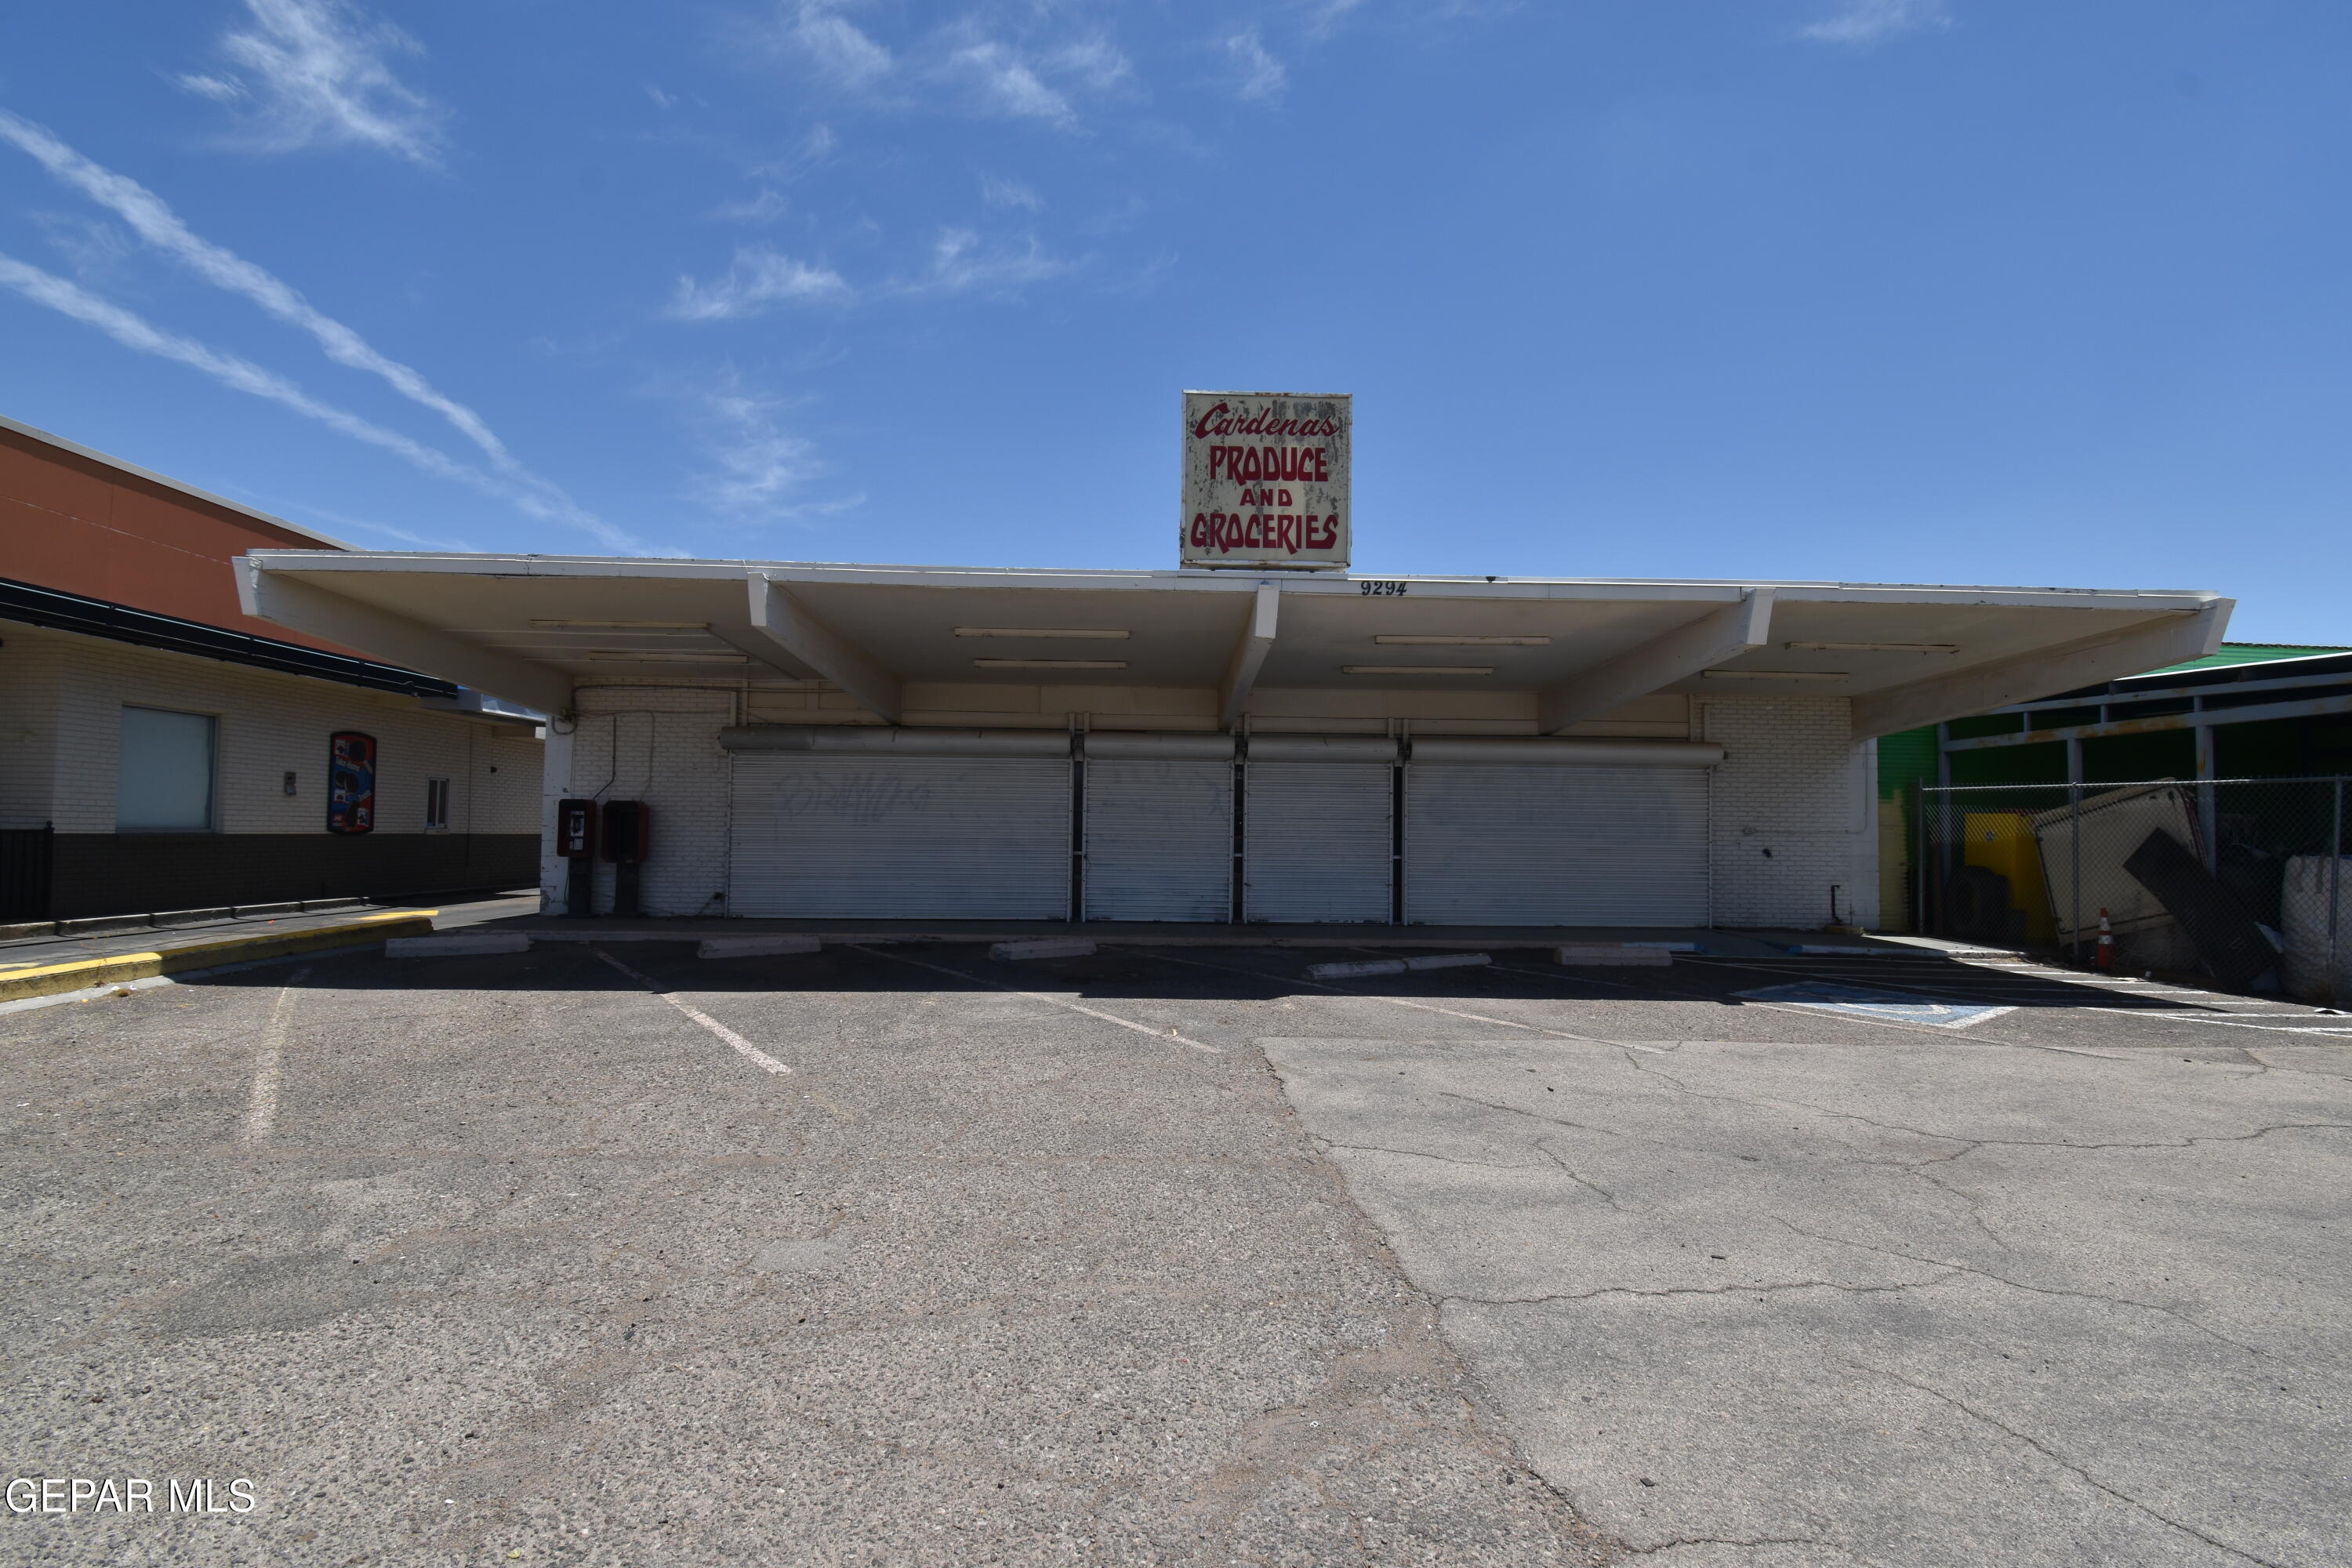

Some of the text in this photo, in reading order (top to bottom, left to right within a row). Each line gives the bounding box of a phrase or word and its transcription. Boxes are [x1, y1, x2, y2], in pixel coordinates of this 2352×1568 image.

[1195, 402, 1341, 439] Cardenas
[1210, 445, 1329, 486] PRODUCE
[1240, 488, 1293, 506] AND
[1190, 513, 1339, 554] GROCERIES
[1361, 581, 1407, 596] 9294
